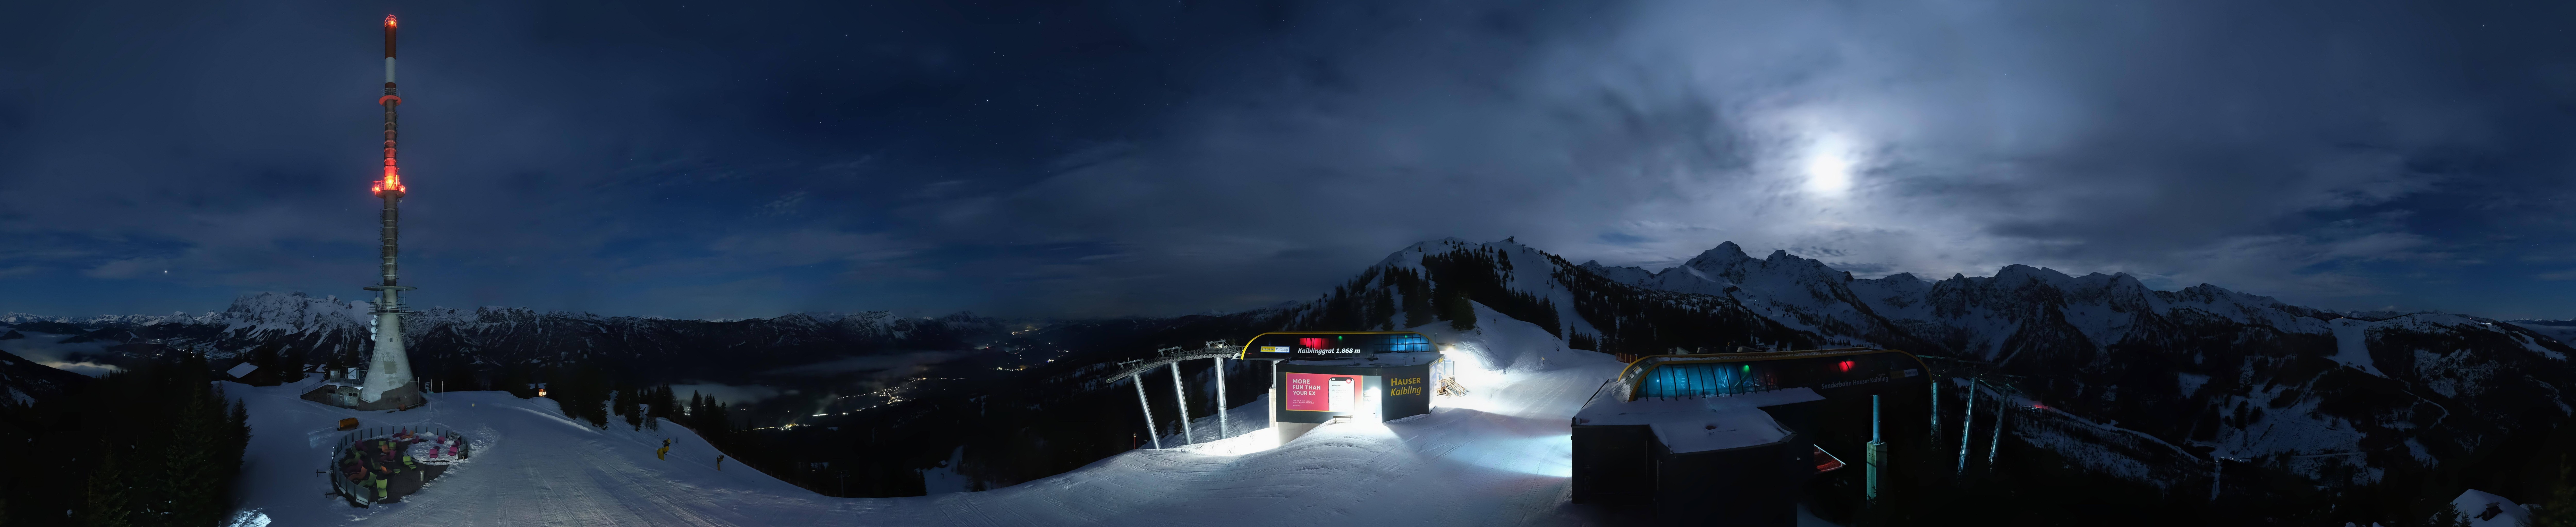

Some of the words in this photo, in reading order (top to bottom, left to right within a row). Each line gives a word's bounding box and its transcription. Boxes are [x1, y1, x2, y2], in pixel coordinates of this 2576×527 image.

[1391, 377, 1421, 386] HAUSER
[1821, 381, 1852, 389] Senderbahn
[1391, 386, 1421, 396] Kaibling
